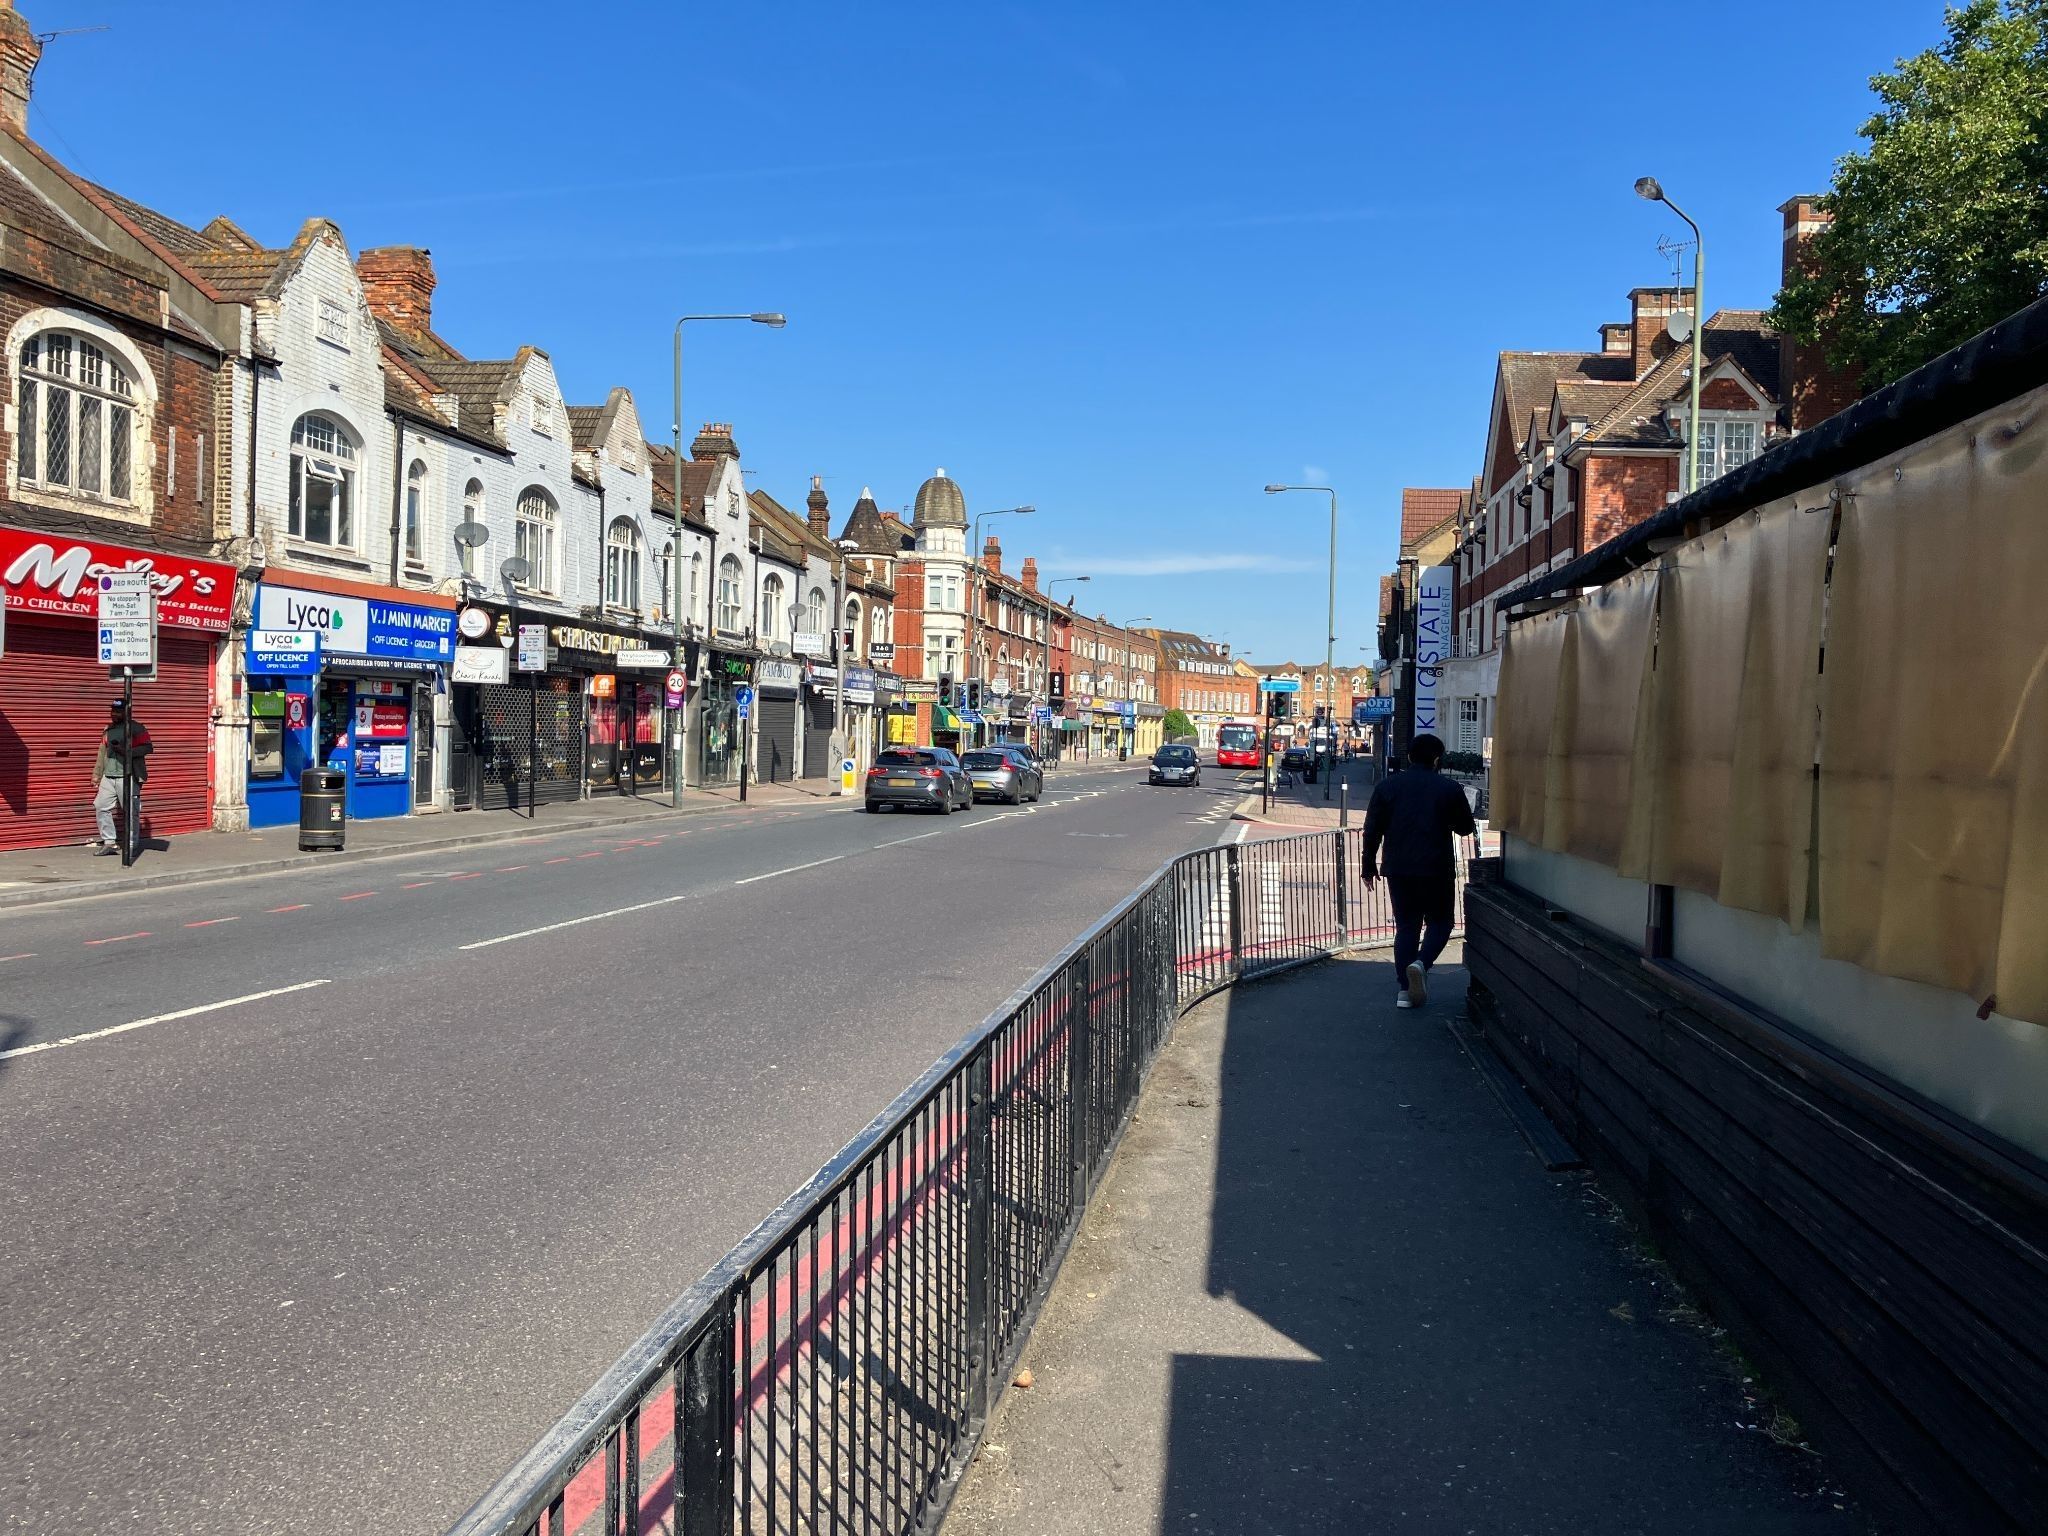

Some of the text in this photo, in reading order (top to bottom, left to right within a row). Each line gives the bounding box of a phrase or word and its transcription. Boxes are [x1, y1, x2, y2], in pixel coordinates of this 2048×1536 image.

[27, 597, 91, 613] CHICKEN
[117, 595, 141, 603] stopping
[188, 602, 226, 614] Better
[287, 597, 330, 631] Lyca
[177, 614, 201, 627] BBQ
[202, 618, 228, 629] RIBS
[387, 610, 412, 628] MINI
[412, 614, 451, 633] MARKET
[1440, 587, 1451, 658] ANAGEMENT
[264, 633, 293, 646] Lyca
[374, 634, 437, 650] OFF LICENCE GROCERY
[257, 653, 309, 662] OFF LICENCE
[374, 660, 390, 668] FOODS
[403, 661, 423, 670] LICENCE
[670, 679, 684, 688] 20
[1367, 698, 1392, 708] OFF
